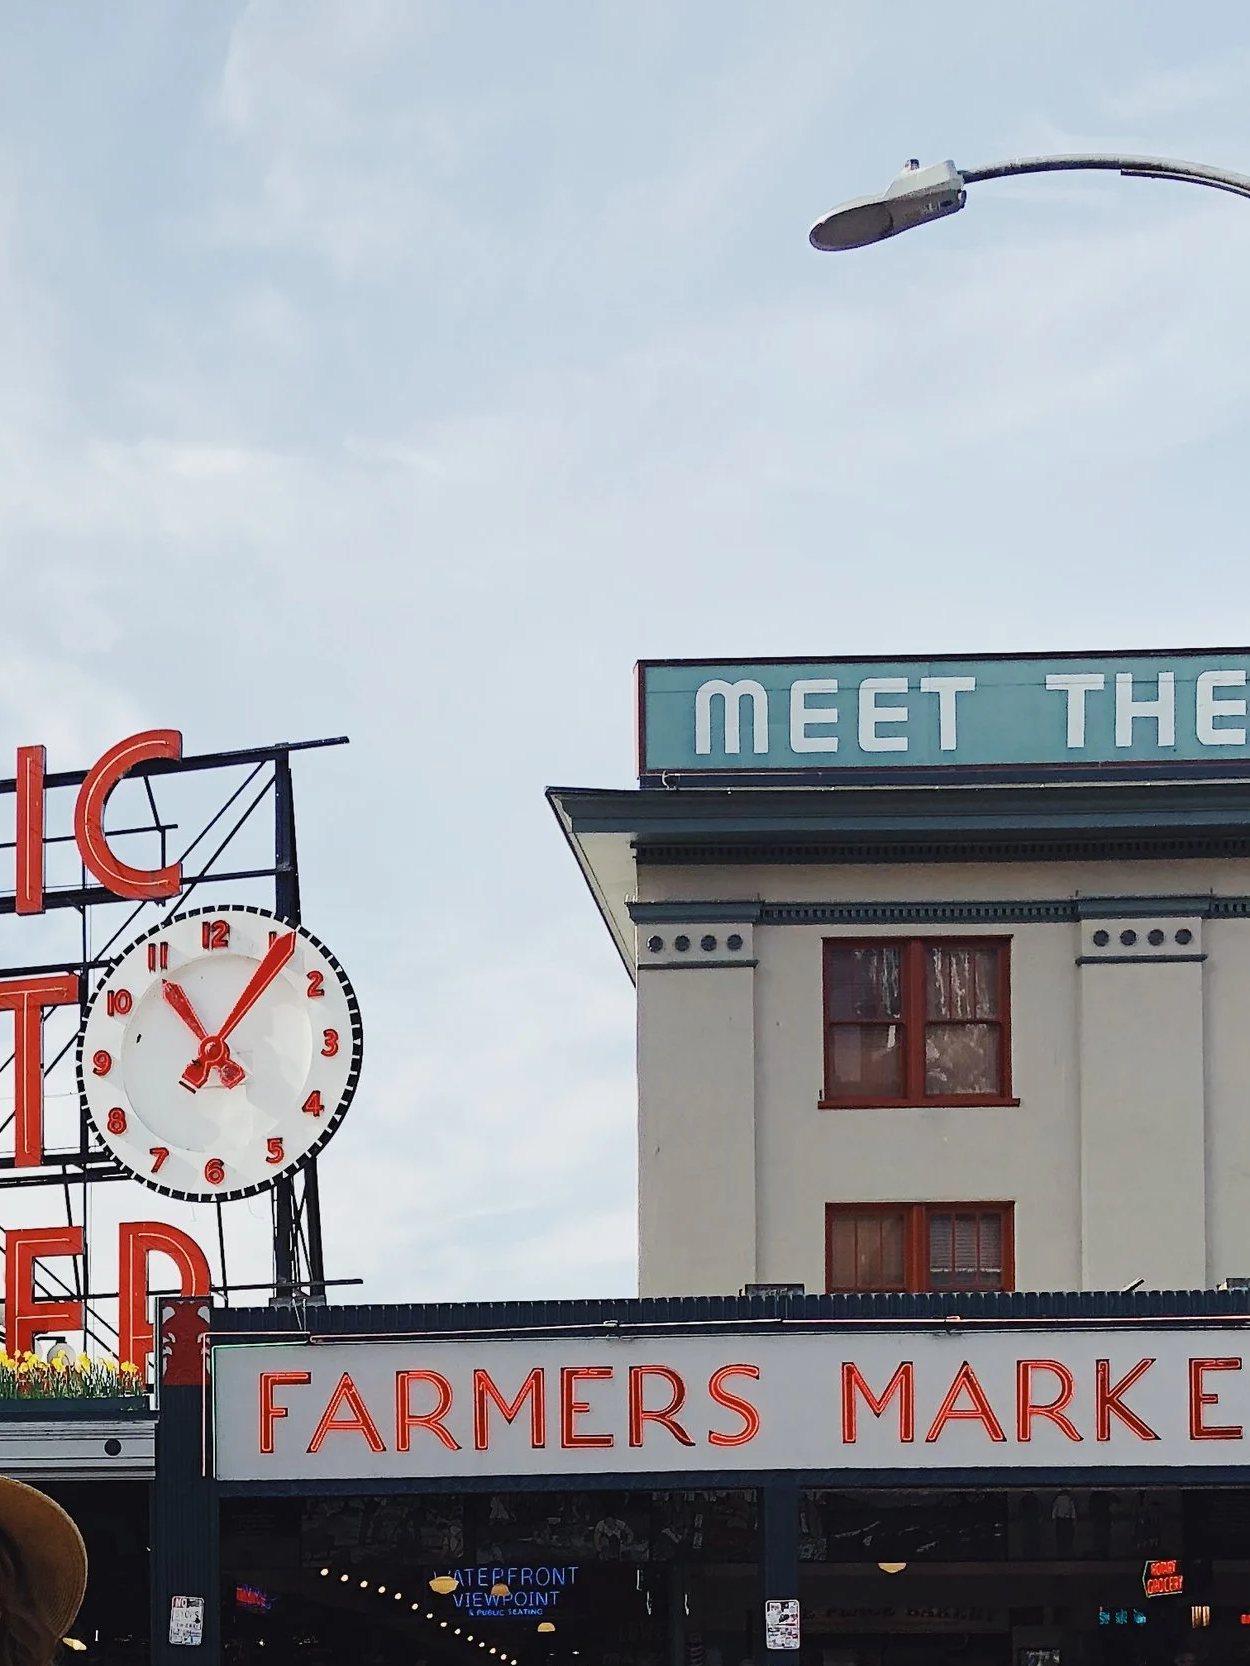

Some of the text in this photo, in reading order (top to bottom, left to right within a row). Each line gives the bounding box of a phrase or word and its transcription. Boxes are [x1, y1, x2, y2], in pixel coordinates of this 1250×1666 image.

[694, 669, 1248, 755] MEET THE
[201, 919, 231, 950] 12
[147, 941, 169, 973] 11
[306, 970, 325, 998] 2
[106, 988, 133, 1017] 10
[320, 1028, 339, 1057] 3
[92, 1049, 112, 1077] 9
[301, 1090, 325, 1118] 4
[106, 1107, 127, 1135] 8
[149, 1146, 170, 1174] 7
[265, 1137, 285, 1165] 5
[204, 1158, 225, 1185] 6
[258, 1356, 1245, 1454] FARMERS MARKE
[434, 1566, 579, 1587] ATERFRONT
[452, 1590, 561, 1608] VIEWPOINT
